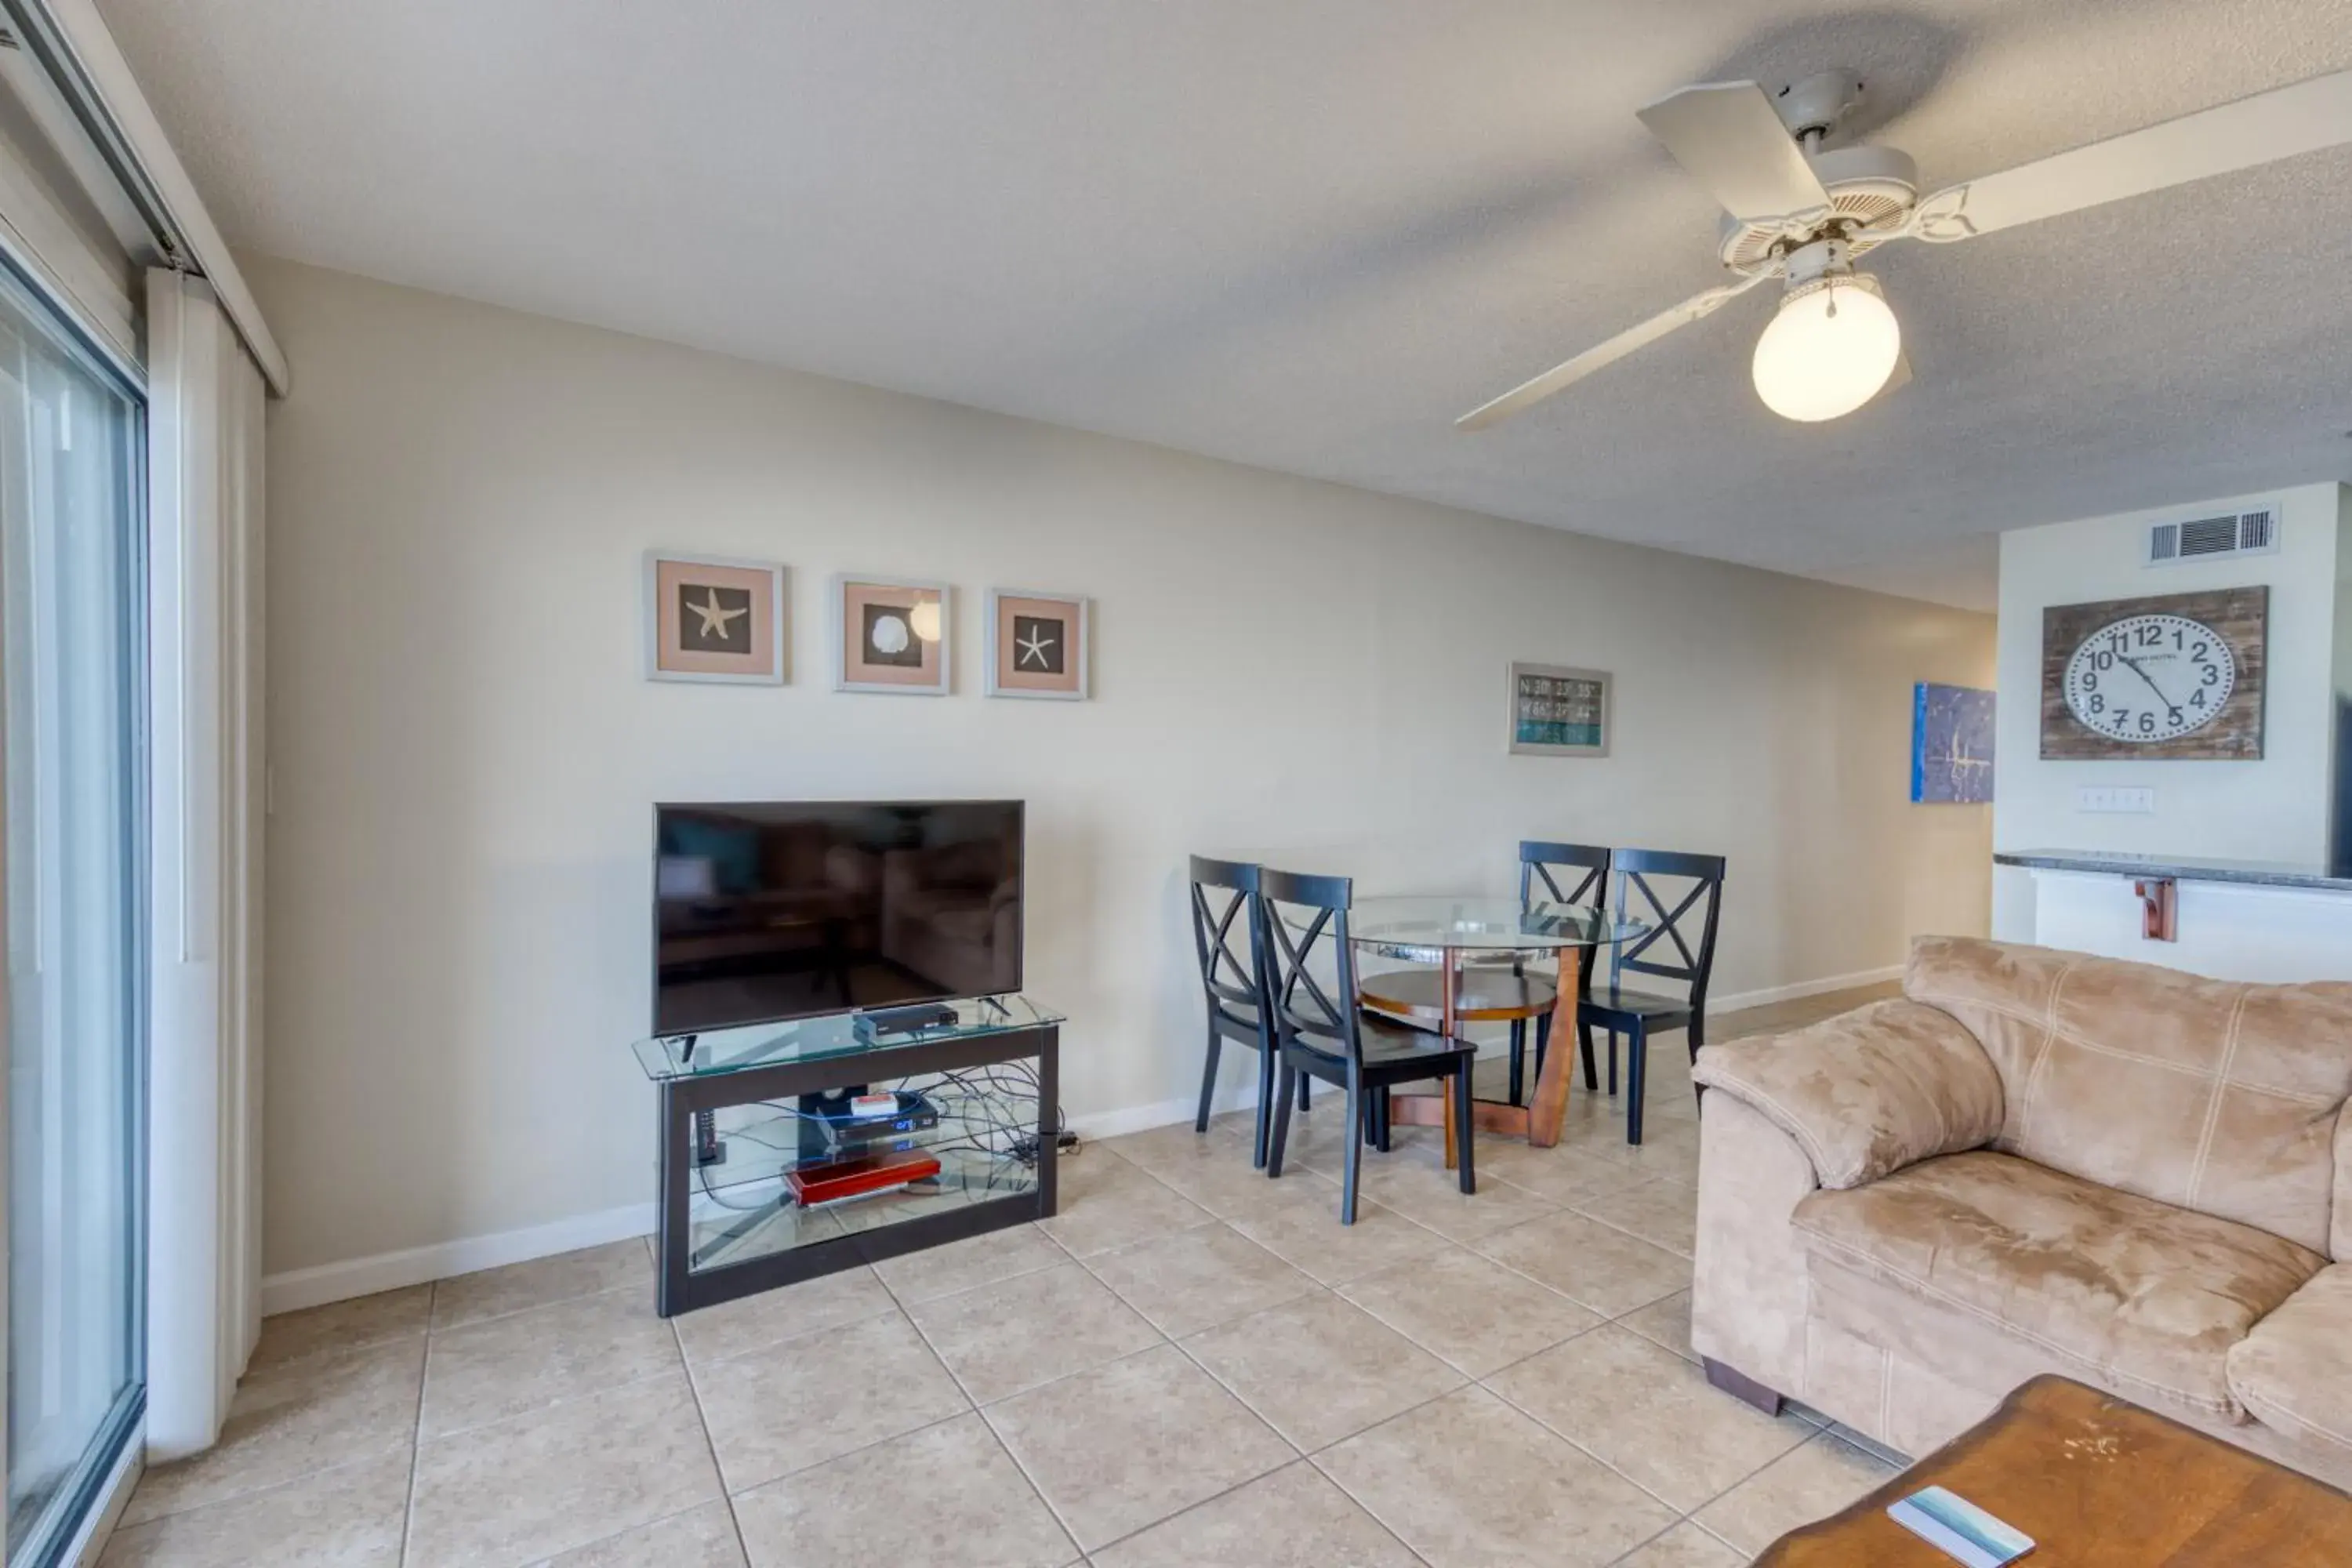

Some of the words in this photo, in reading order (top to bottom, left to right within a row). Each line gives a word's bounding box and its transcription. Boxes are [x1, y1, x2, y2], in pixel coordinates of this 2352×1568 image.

[2109, 633, 2128, 653] 11
[2133, 625, 2162, 646] 12
[2172, 630, 2182, 650] 1
[2088, 651, 2113, 671] 10
[2191, 642, 2207, 662] 2
[2082, 672, 2097, 692] 9
[2201, 665, 2219, 685] 3
[2090, 694, 2104, 714] 8
[2189, 688, 2206, 709] 4
[2113, 710, 2129, 729] 7
[2139, 713, 2154, 732] 6
[2168, 706, 2184, 727] 5
